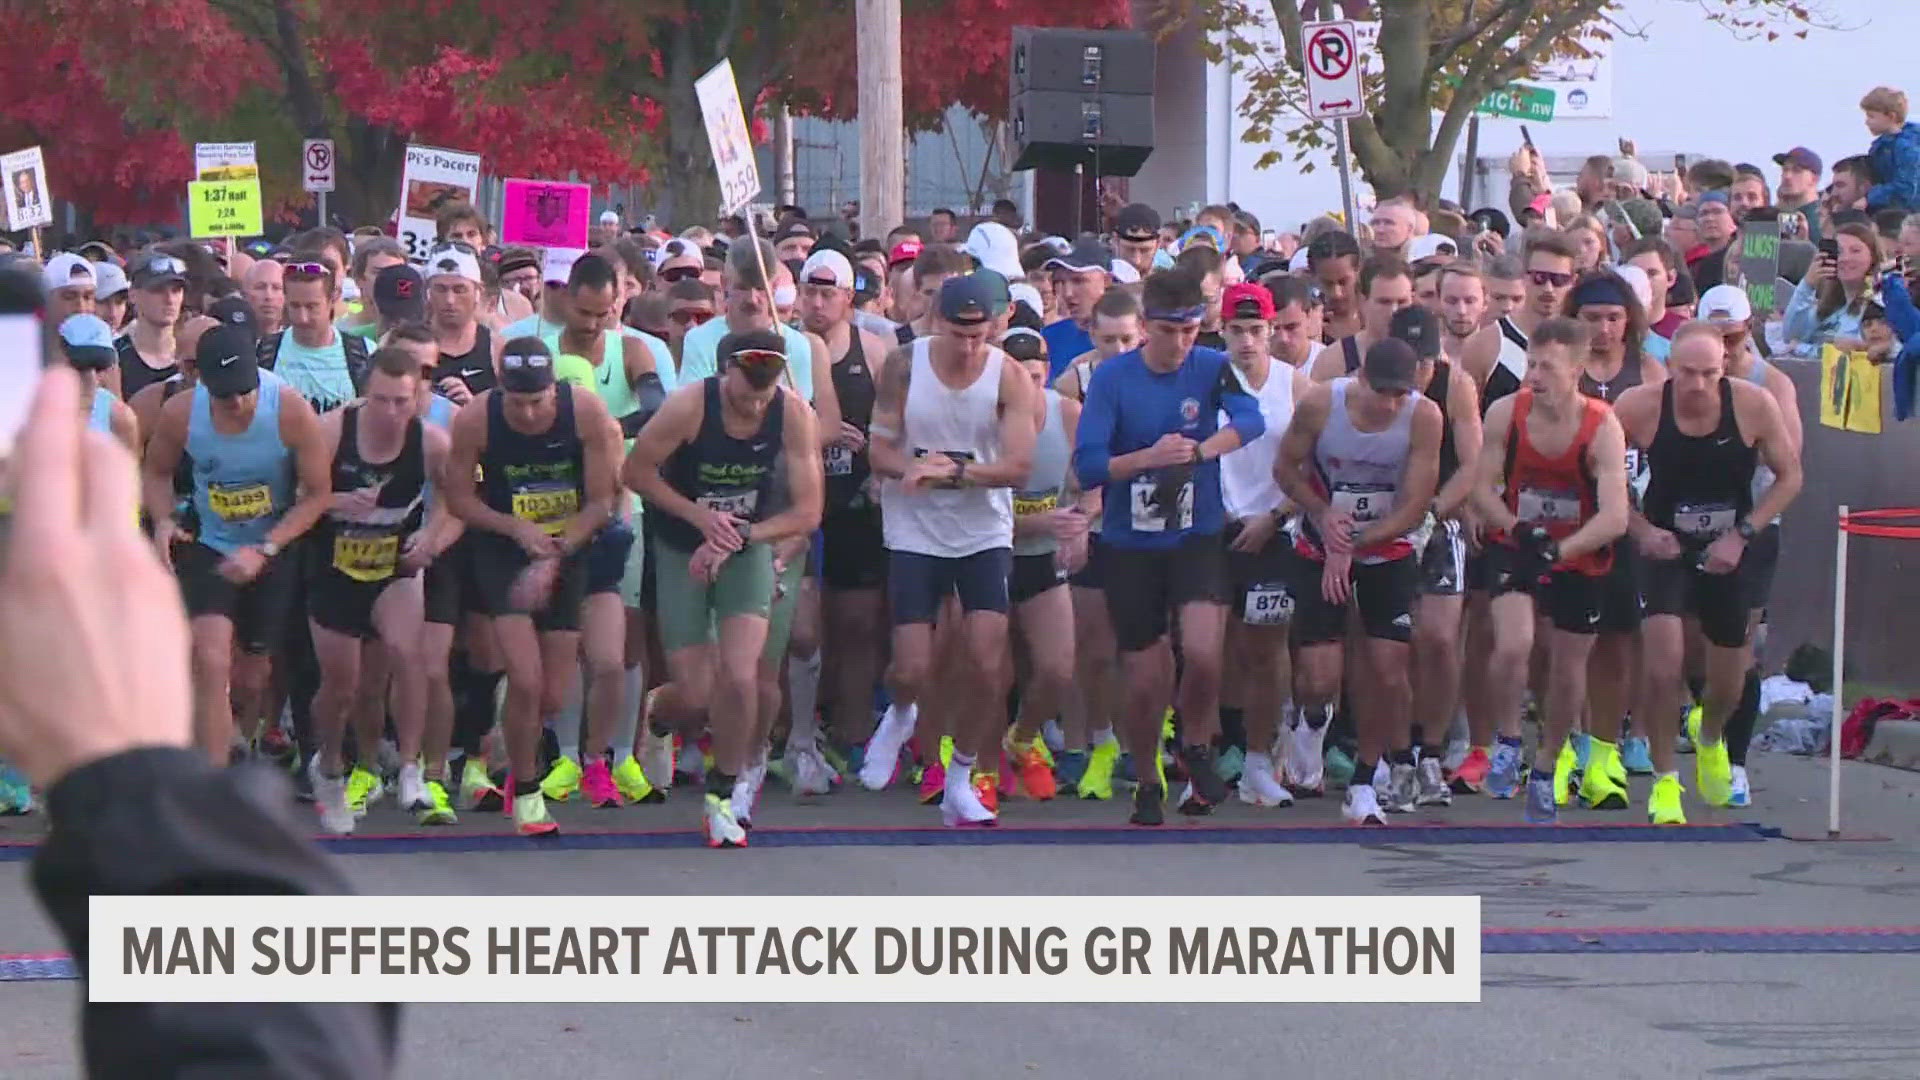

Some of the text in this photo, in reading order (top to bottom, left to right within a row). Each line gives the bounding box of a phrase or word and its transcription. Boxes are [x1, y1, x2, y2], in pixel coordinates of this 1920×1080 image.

[407, 151, 478, 173] Pi's Pacers
[724, 164, 757, 208] 2:59
[203, 188, 227, 202] 1:37
[1356, 497, 1368, 510] 8
[1699, 515, 1711, 528] 9
